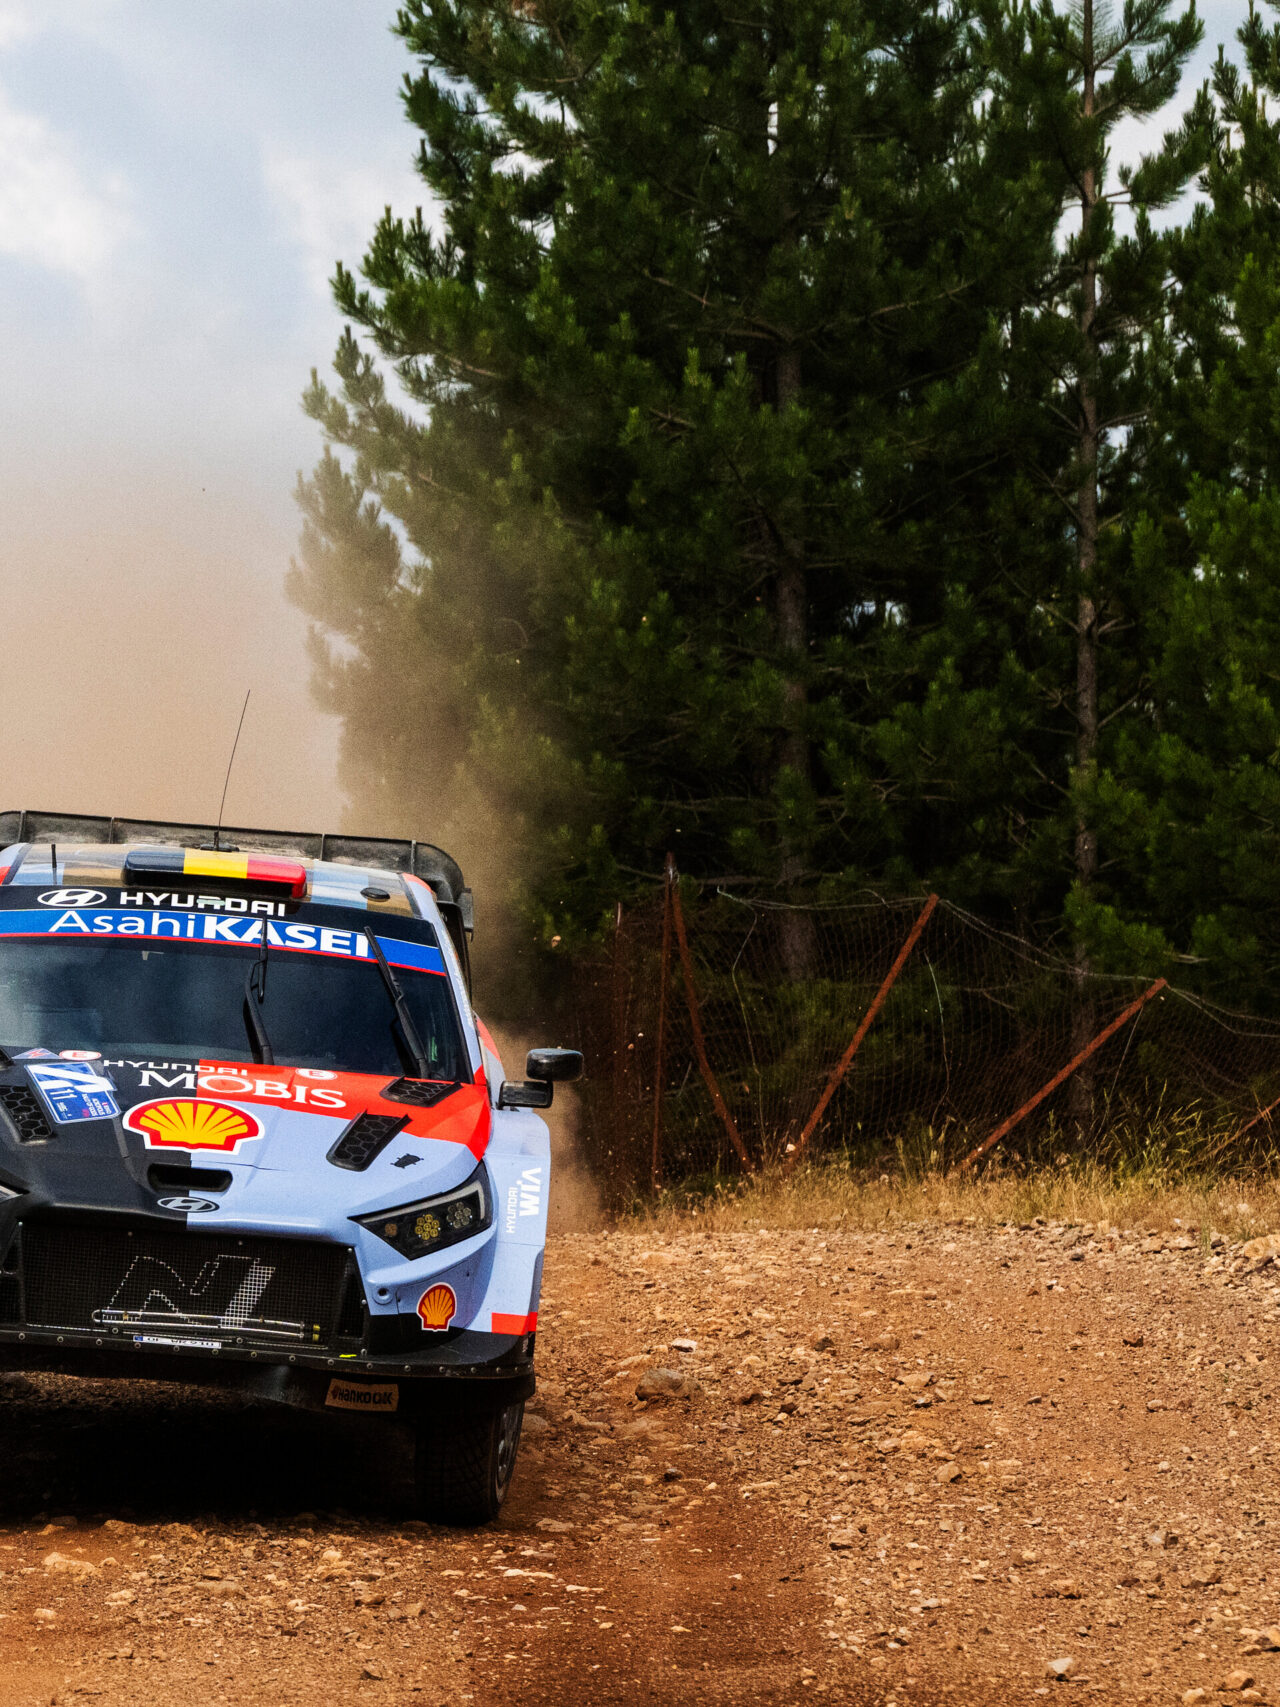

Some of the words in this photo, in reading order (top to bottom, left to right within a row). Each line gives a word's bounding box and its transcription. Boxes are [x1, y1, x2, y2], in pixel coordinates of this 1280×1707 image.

[120, 892, 286, 917] HYUNDAI
[103, 1060, 248, 1076] HYUNDAI
[138, 1070, 347, 1108] MOBIS
[506, 1187, 518, 1234] HYUNDAI
